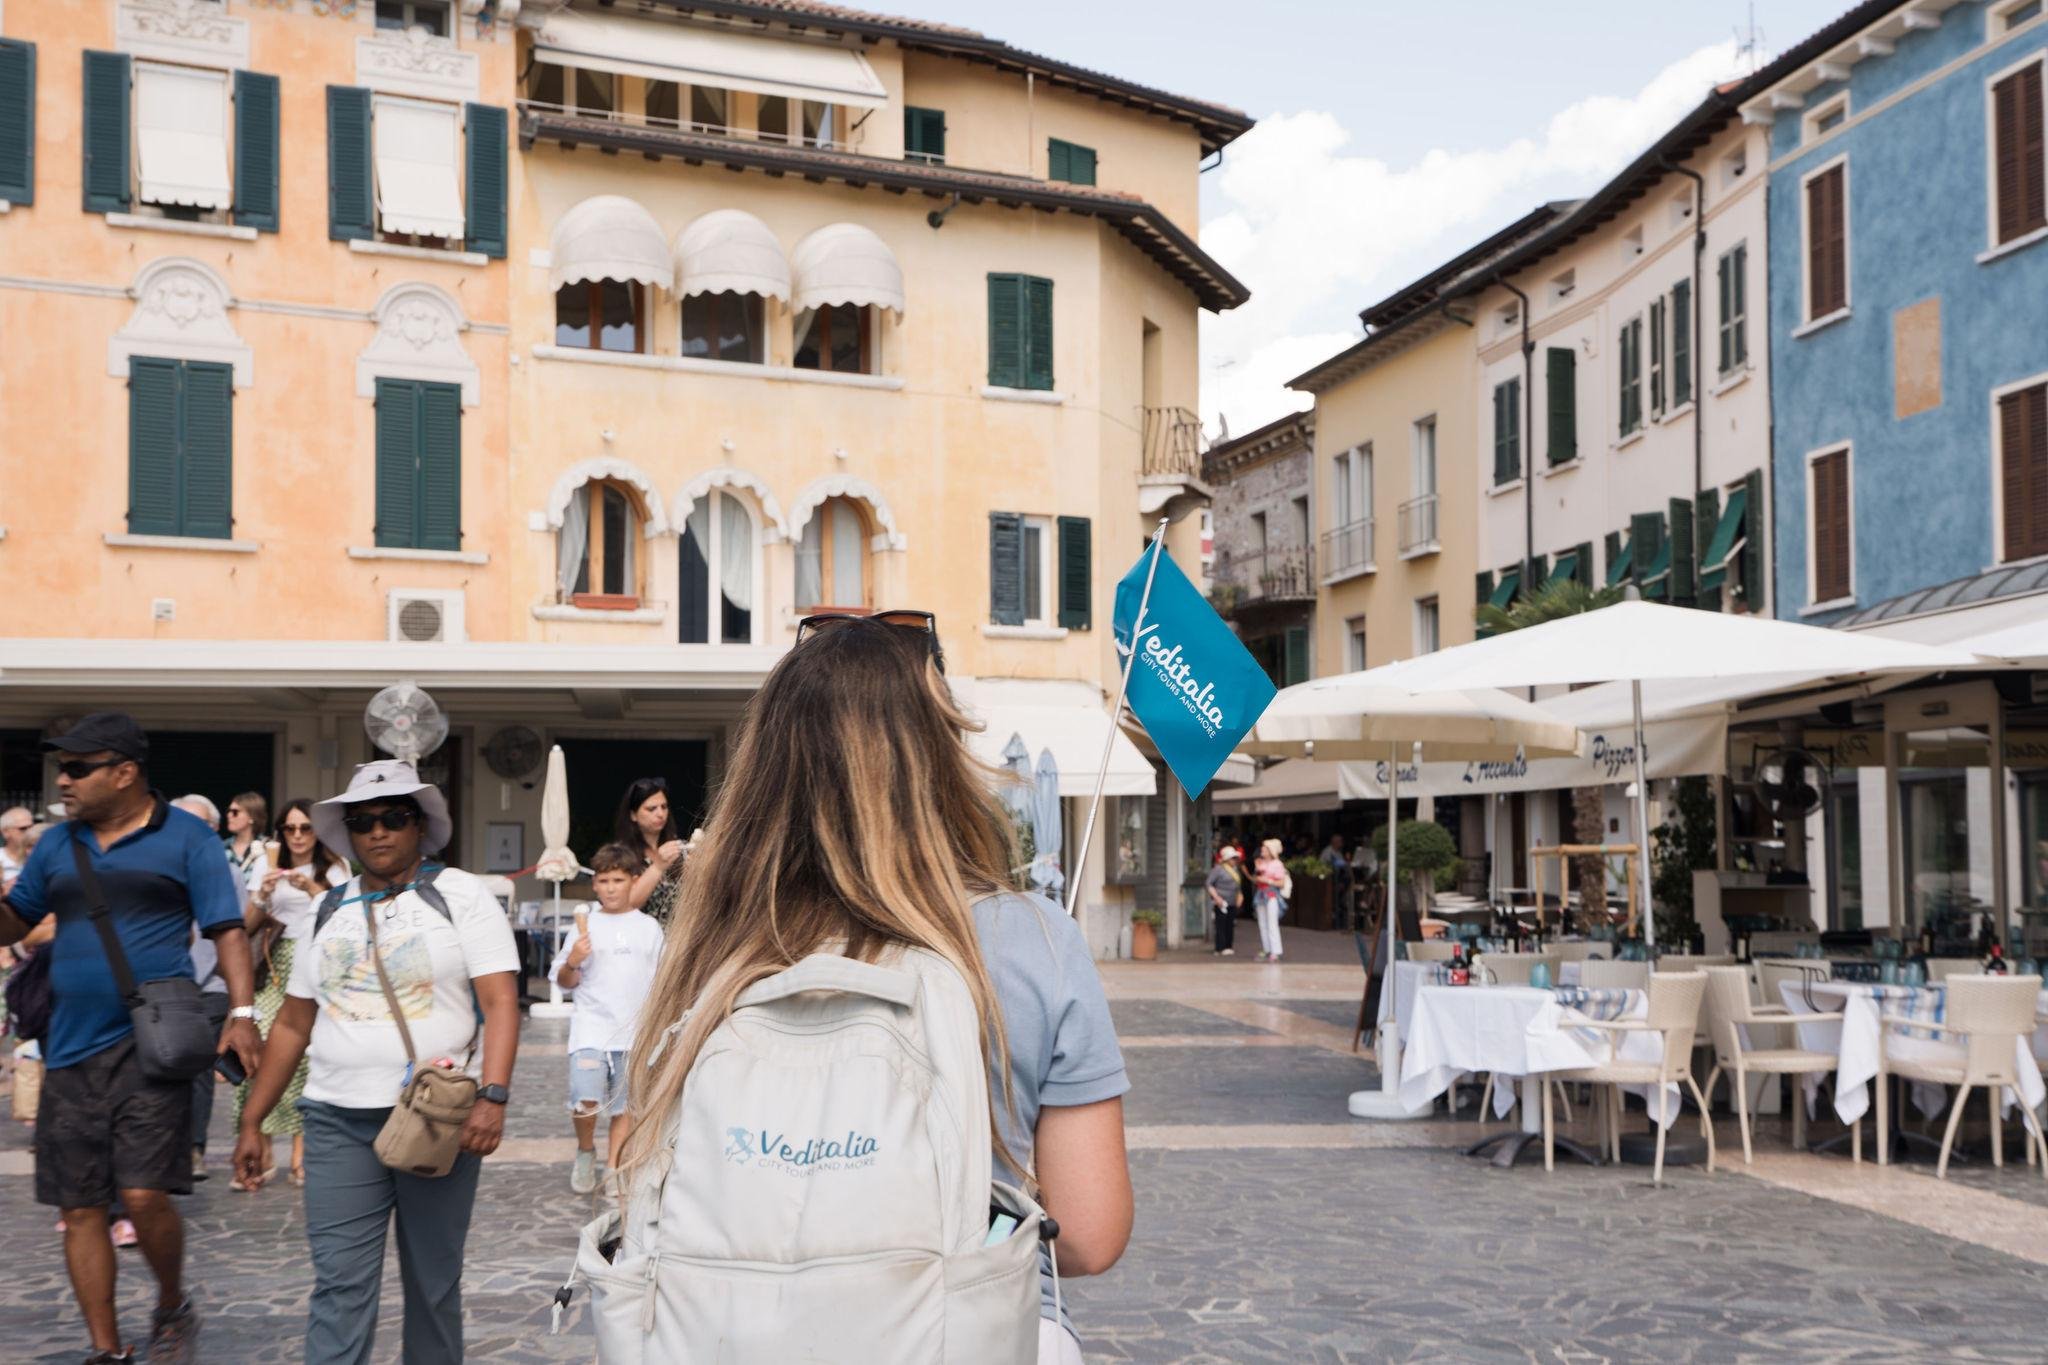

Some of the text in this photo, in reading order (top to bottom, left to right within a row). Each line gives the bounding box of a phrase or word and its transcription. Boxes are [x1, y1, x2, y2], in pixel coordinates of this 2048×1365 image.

[1141, 652, 1216, 739] CITY TOURS AND MORE
[758, 1157, 781, 1171] CITY
[816, 1160, 841, 1173] AND
[844, 1156, 877, 1170] MORE
[761, 1130, 880, 1166] Veditalia
